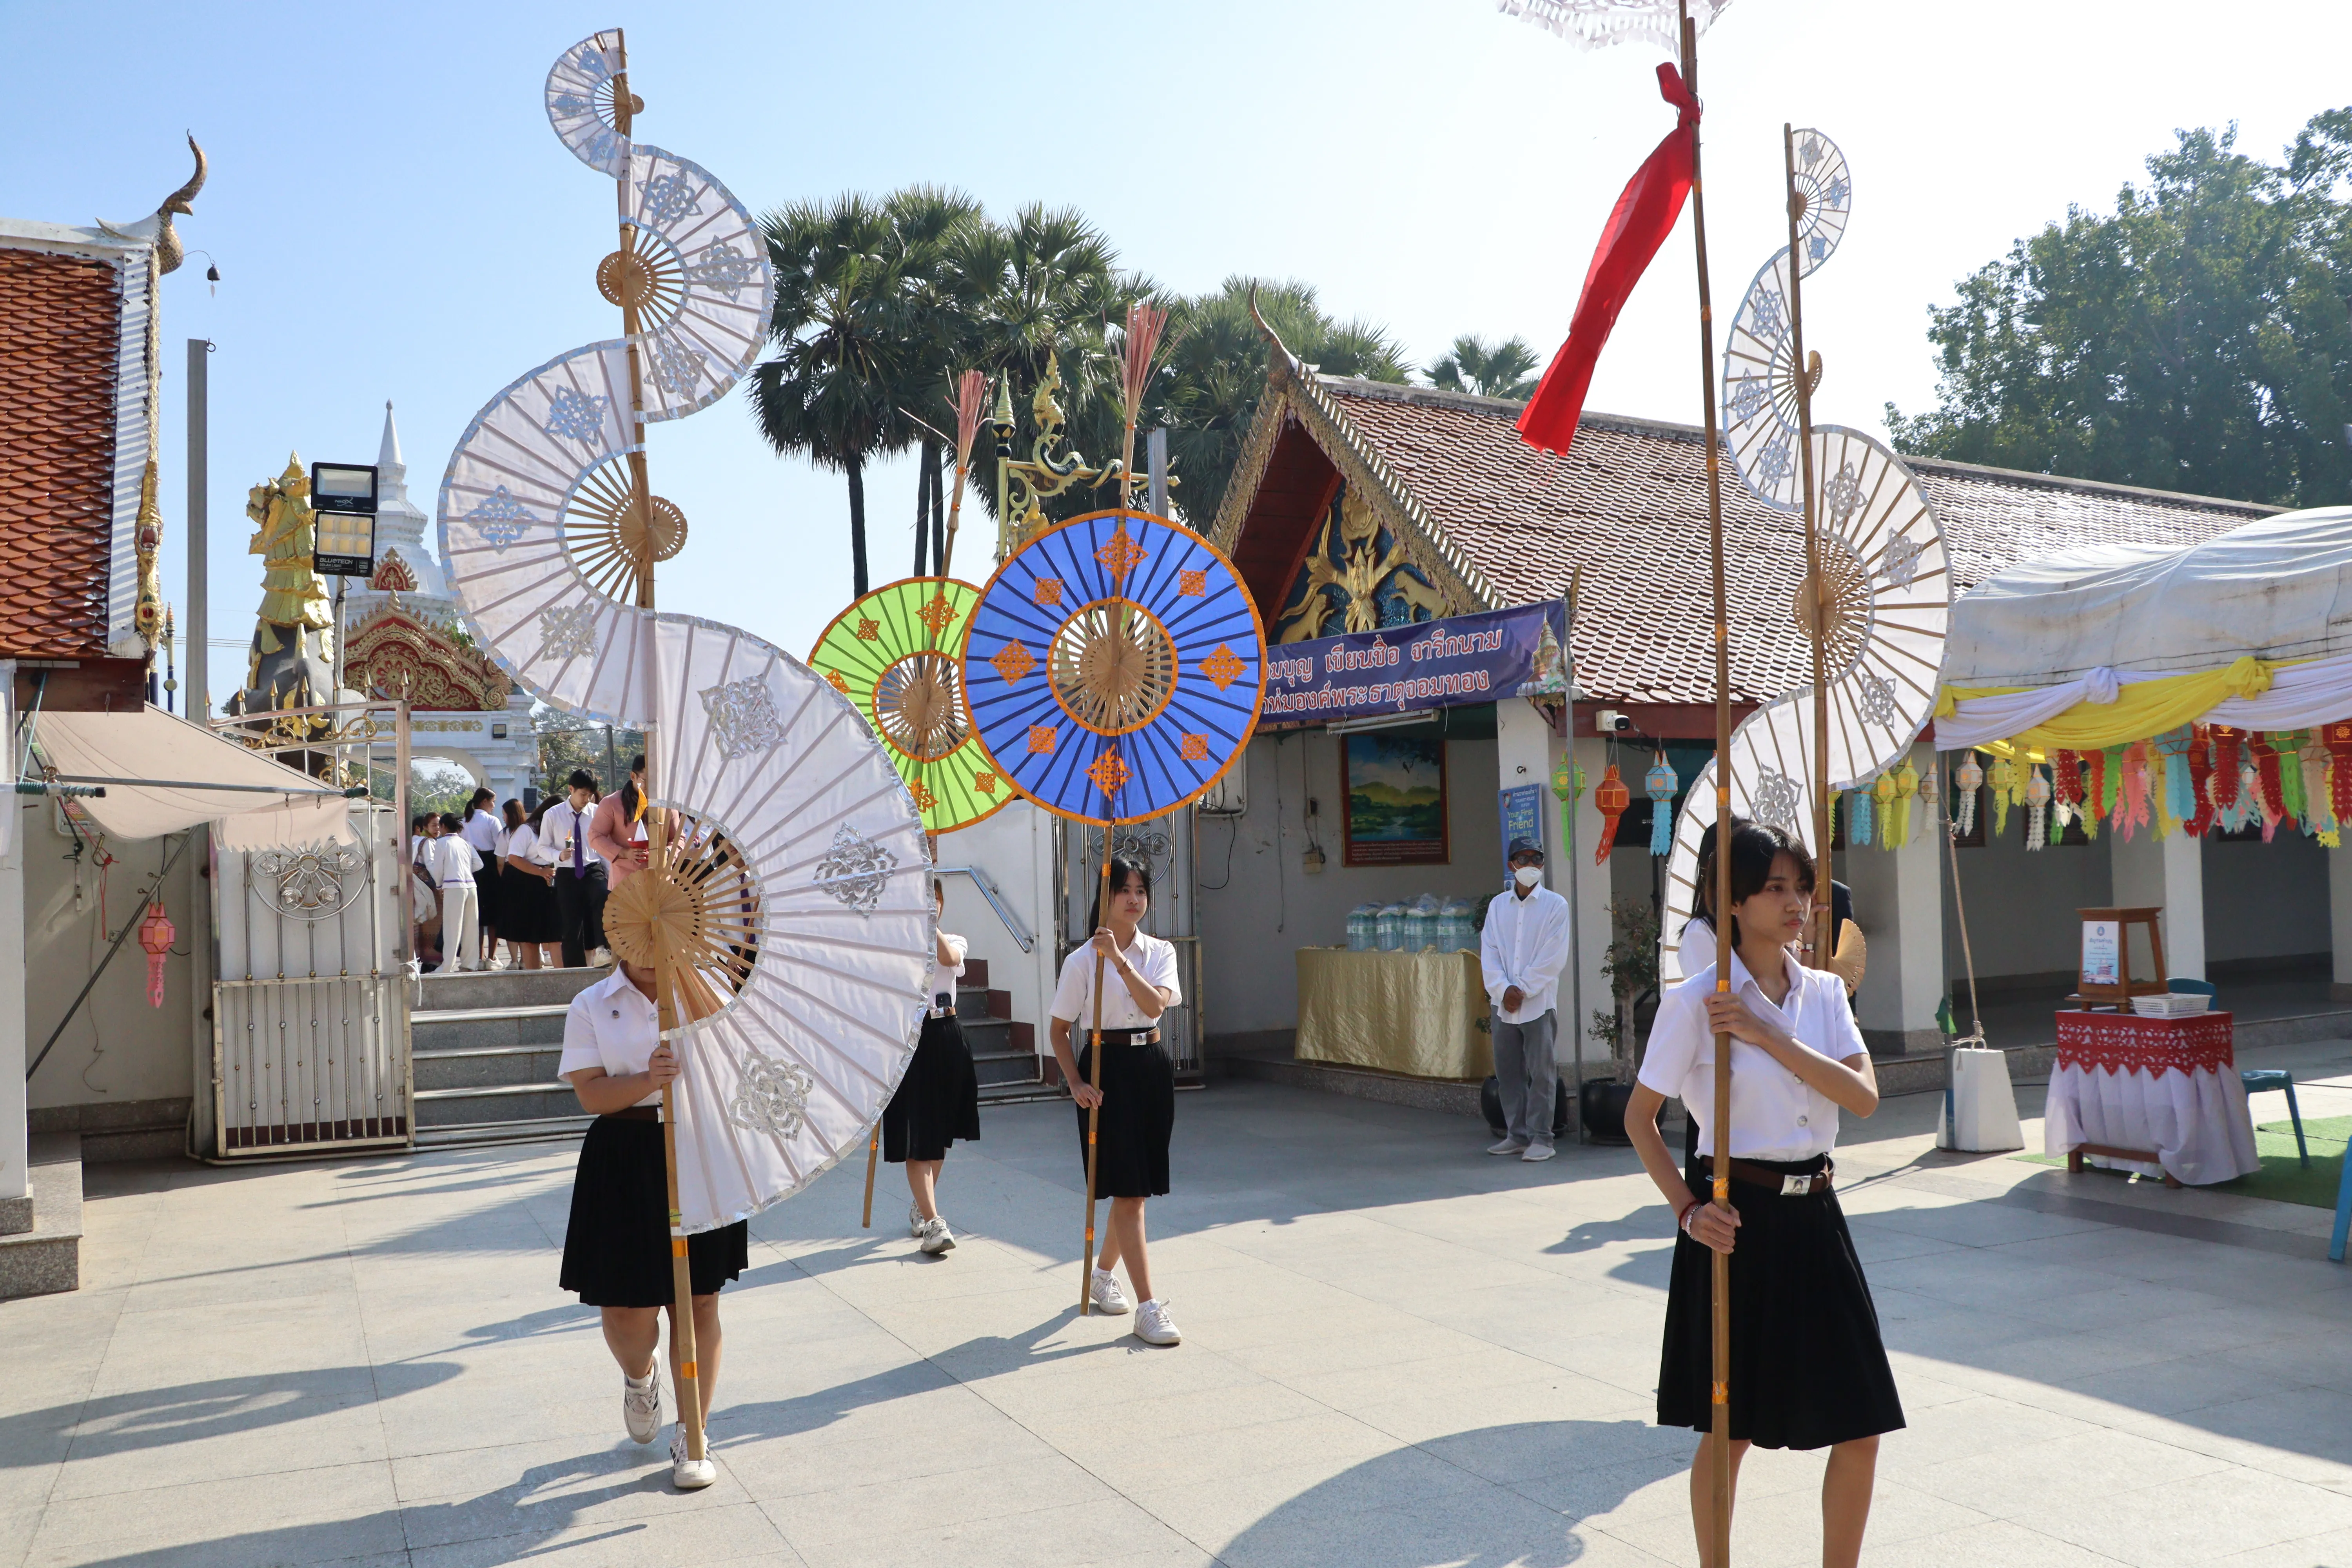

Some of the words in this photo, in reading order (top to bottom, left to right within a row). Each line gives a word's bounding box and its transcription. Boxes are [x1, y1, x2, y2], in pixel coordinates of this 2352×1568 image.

[1325, 634, 1400, 673] เขียนชื่อ
[1411, 628, 1503, 662] จารึกนาม
[1508, 816, 1534, 831] Friend
